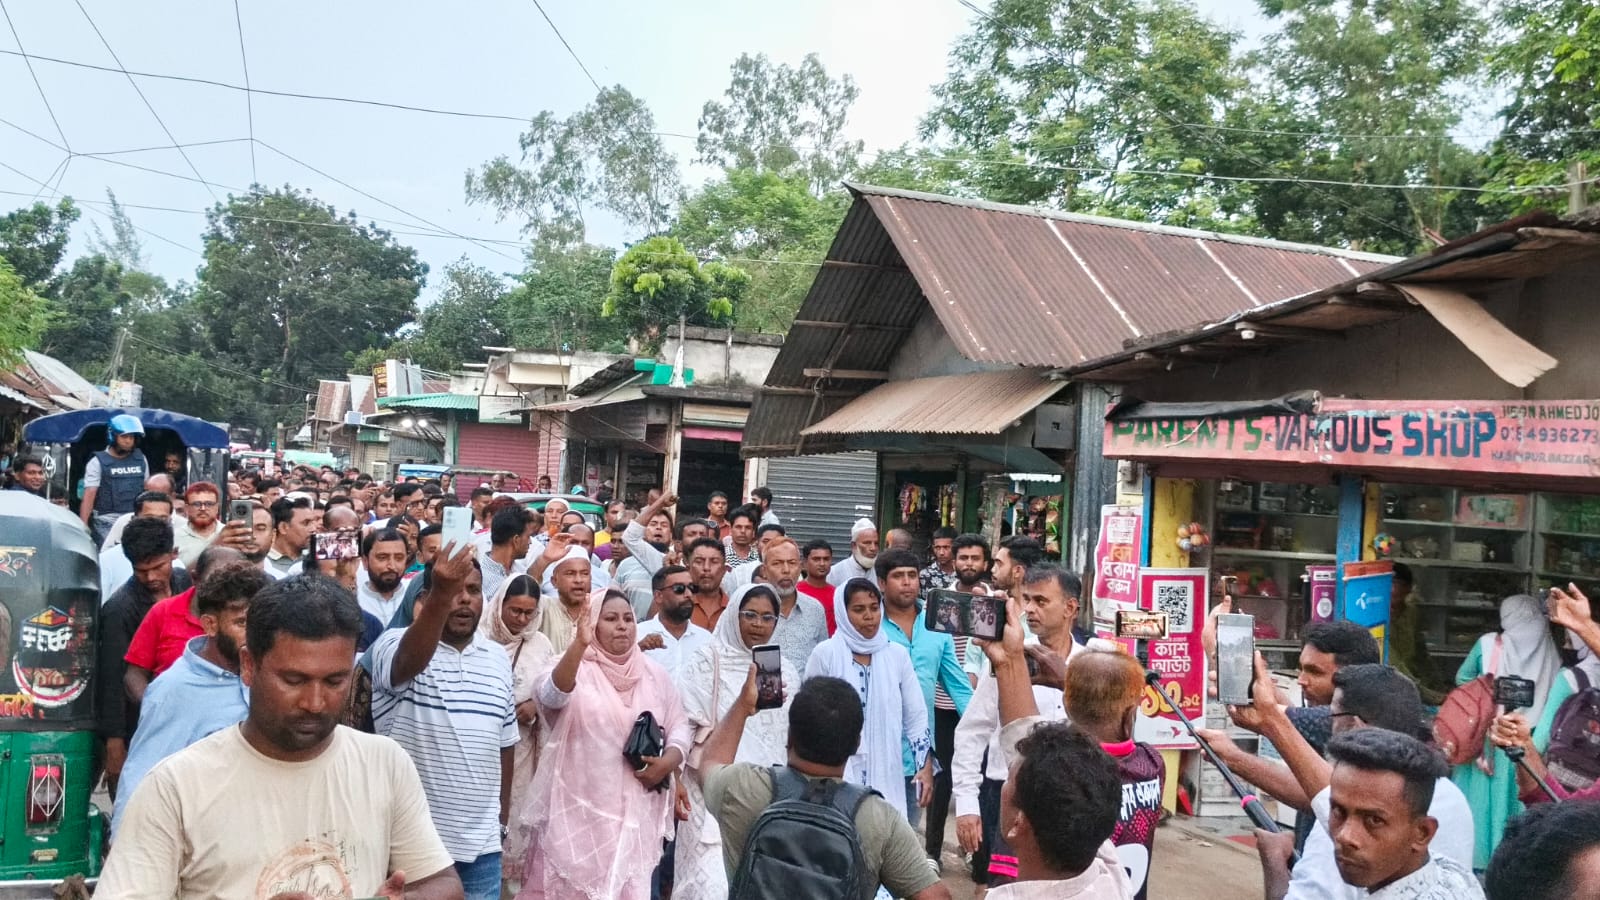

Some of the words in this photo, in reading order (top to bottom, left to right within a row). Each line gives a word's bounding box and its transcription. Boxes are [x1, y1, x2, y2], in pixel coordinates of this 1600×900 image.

[1540, 405, 1582, 420] AHMED
[1112, 418, 1262, 451] PARENTS
[1275, 414, 1394, 454] VAROUS
[1403, 411, 1497, 458] SHOP
[111, 466, 142, 475] POLICE
[1101, 556, 1137, 580] বিকাশ
[1154, 643, 1189, 656] ক্যাশ
[1151, 656, 1192, 673] আউট
